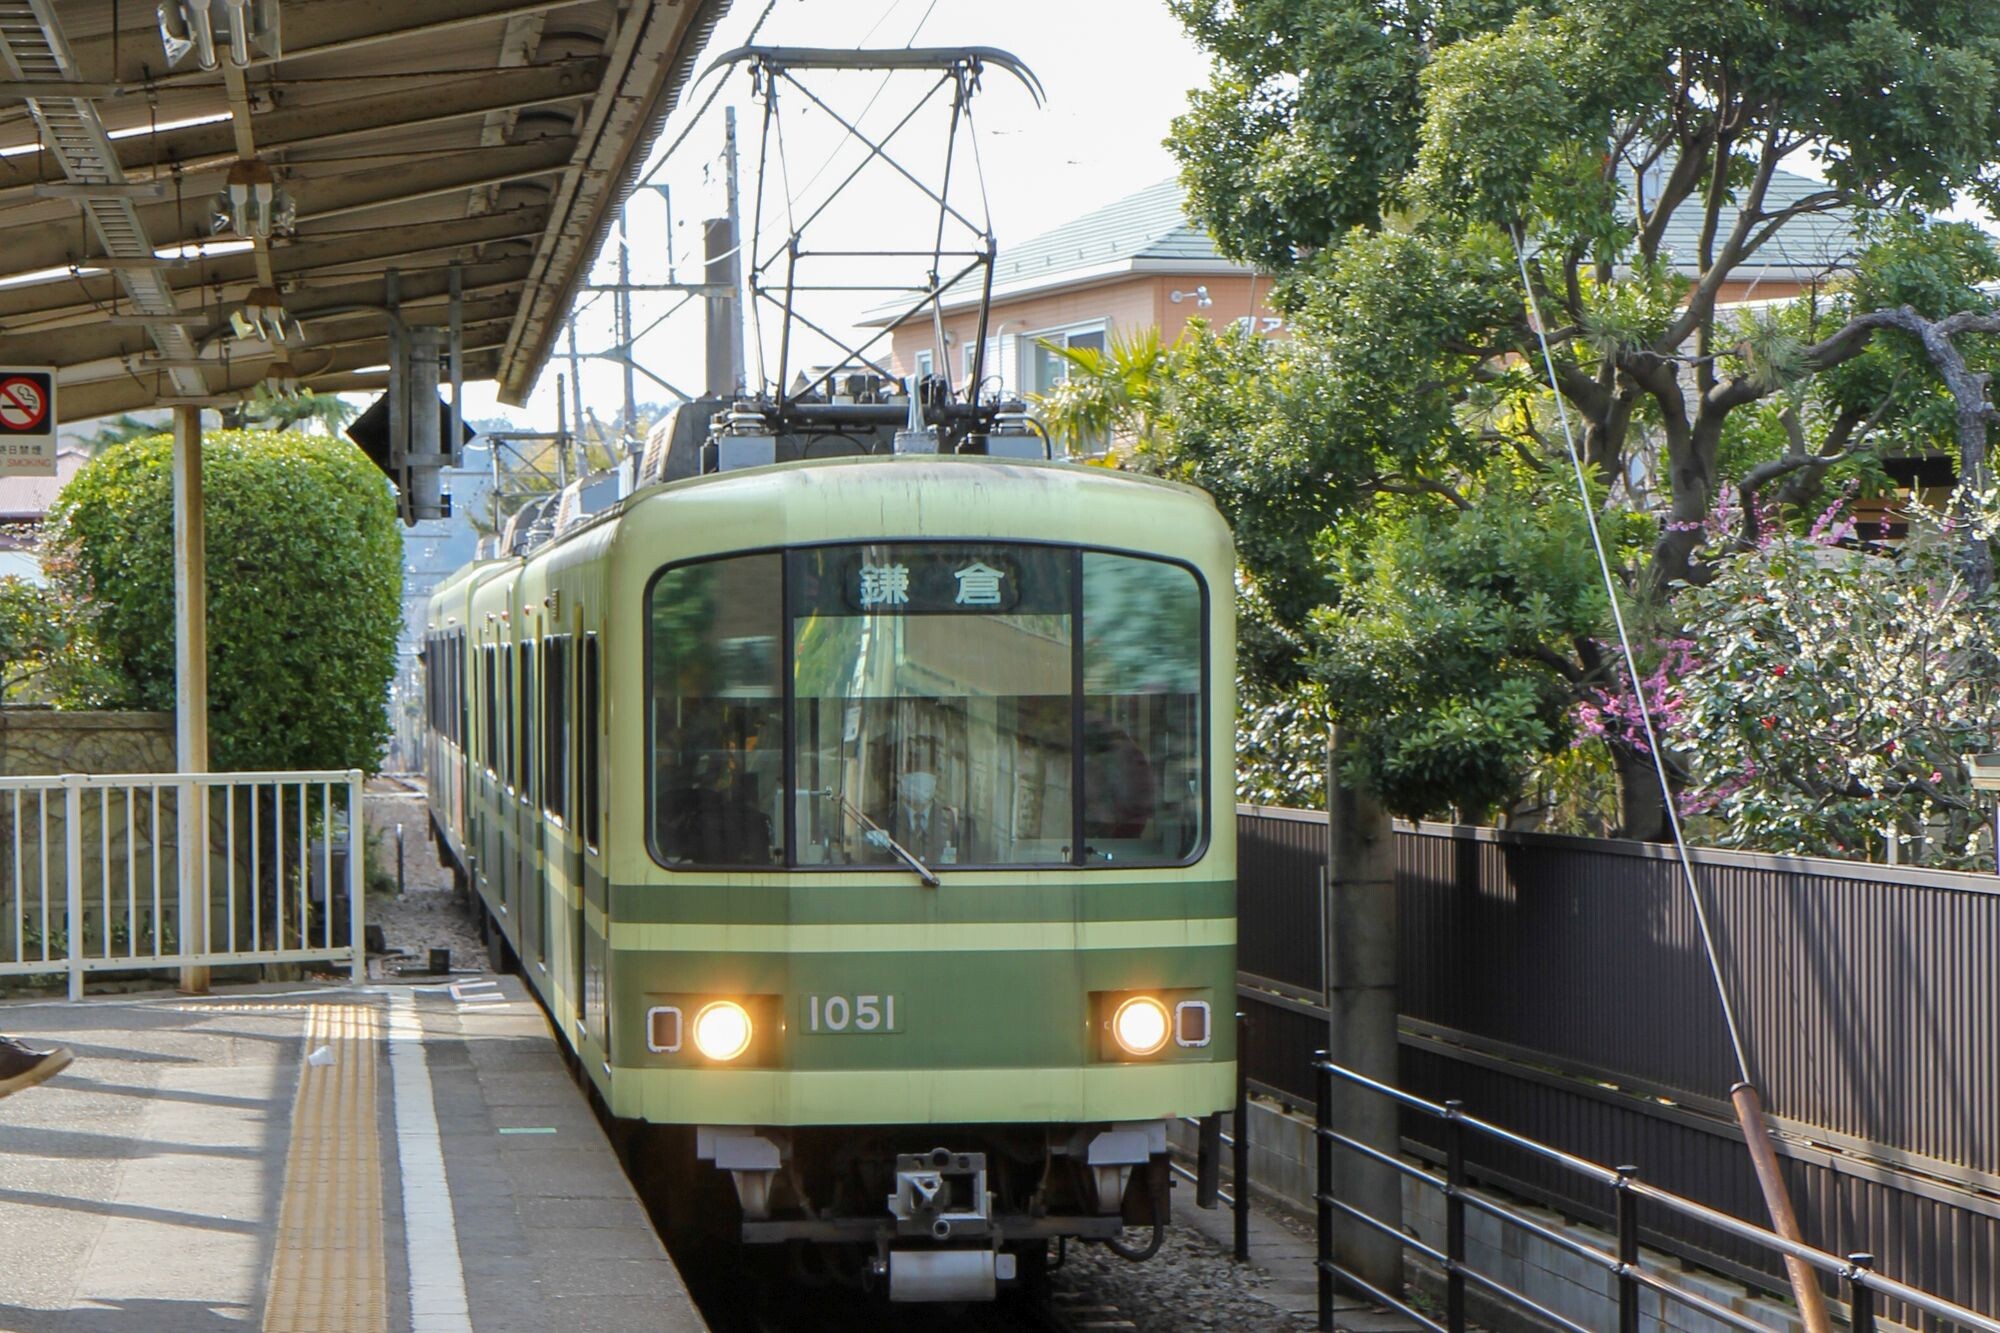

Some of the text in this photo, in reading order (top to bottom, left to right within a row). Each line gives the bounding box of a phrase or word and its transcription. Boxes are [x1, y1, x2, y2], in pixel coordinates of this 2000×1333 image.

[8, 459, 51, 468] SMOKING
[859, 562, 1005, 605] 鎌倉
[810, 995, 894, 1031] 1051
